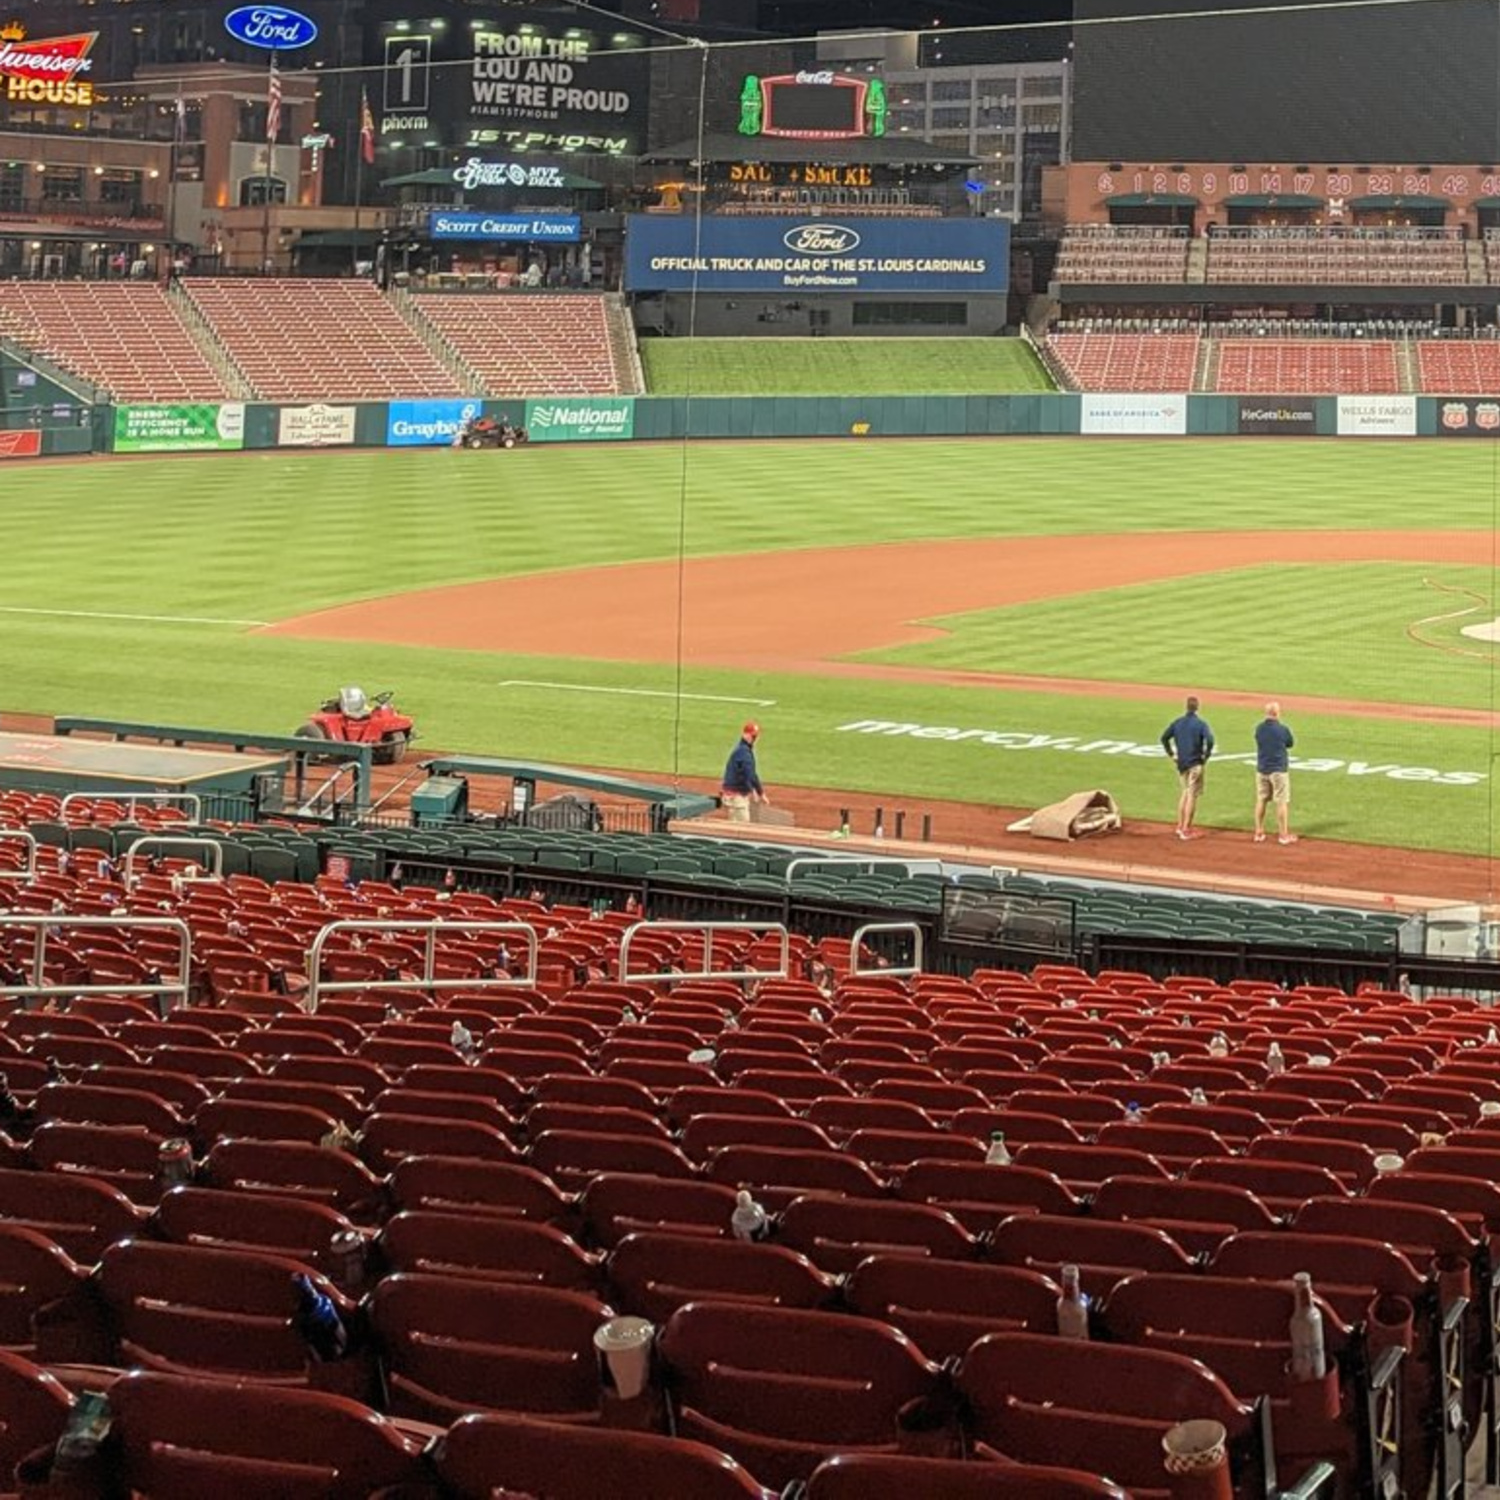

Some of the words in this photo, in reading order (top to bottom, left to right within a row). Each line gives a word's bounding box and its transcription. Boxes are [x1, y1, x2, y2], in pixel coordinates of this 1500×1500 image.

[245, 10, 301, 42] Ford
[474, 32, 542, 60] FROM
[546, 38, 589, 63] THE
[473, 56, 519, 80] LOU
[525, 61, 573, 85] AND
[8, 77, 92, 106] HOUSE
[472, 81, 547, 108] WE'RE
[552, 87, 629, 113] PROUD
[381, 112, 429, 135] phorm
[470, 130, 521, 142] 1ST
[525, 133, 627, 149] PHORM
[1154, 173, 1167, 192] 2
[1178, 173, 1191, 192] 6
[1203, 174, 1216, 193] 9
[1229, 174, 1248, 193] 10
[1261, 174, 1281, 193] 14
[1294, 174, 1314, 194] 17
[1326, 175, 1350, 194] 20
[1403, 176, 1430, 195] 24
[1442, 176, 1468, 195] 42
[435, 219, 477, 232] SCOTT
[481, 219, 529, 234] CREDIT
[532, 220, 575, 234] UNION
[797, 227, 846, 250] Ford
[651, 257, 708, 271] OFFICIAL
[711, 258, 753, 271] TRUCK
[755, 258, 783, 271] AND
[784, 258, 811, 271] CAR
[812, 258, 829, 271] OF
[831, 258, 856, 272] THE
[857, 259, 876, 272] ST.
[878, 259, 914, 273] LOUIS
[916, 259, 986, 273] CARDINALS
[553, 406, 628, 425] National
[836, 719, 1488, 786] mercy.ne/aves
